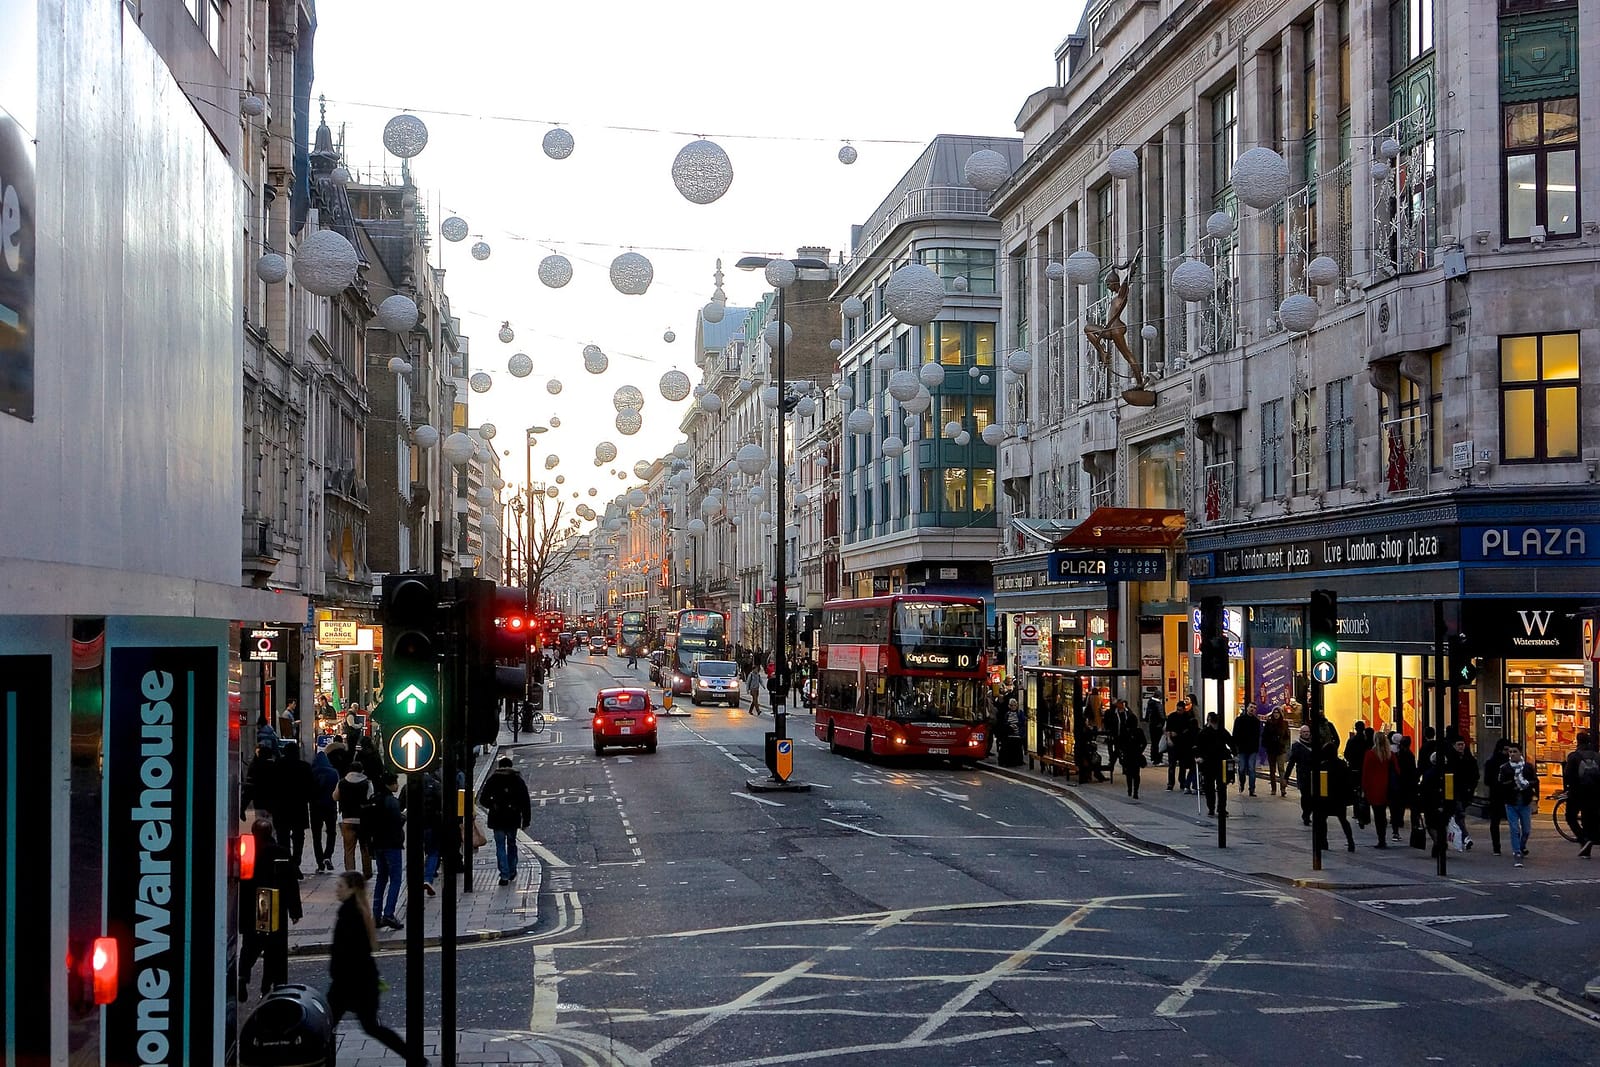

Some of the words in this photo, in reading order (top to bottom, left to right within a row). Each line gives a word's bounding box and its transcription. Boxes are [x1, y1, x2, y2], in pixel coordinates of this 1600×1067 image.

[1323, 540, 1342, 563] live
[1407, 531, 1437, 564] plaza
[1482, 527, 1586, 556] PLAZA
[1061, 560, 1106, 574] PLAZA
[1223, 551, 1238, 571] live
[1287, 544, 1310, 572] plaza
[1336, 612, 1370, 634] erstone's
[1516, 610, 1555, 636] W
[1512, 637, 1560, 646] Waterstone's
[906, 653, 927, 664] King's
[928, 654, 949, 663] Cross
[957, 654, 969, 667] 10
[1095, 653, 1110, 661] SALE
[131, 670, 174, 962] Warehouse
[136, 967, 171, 1067] one
